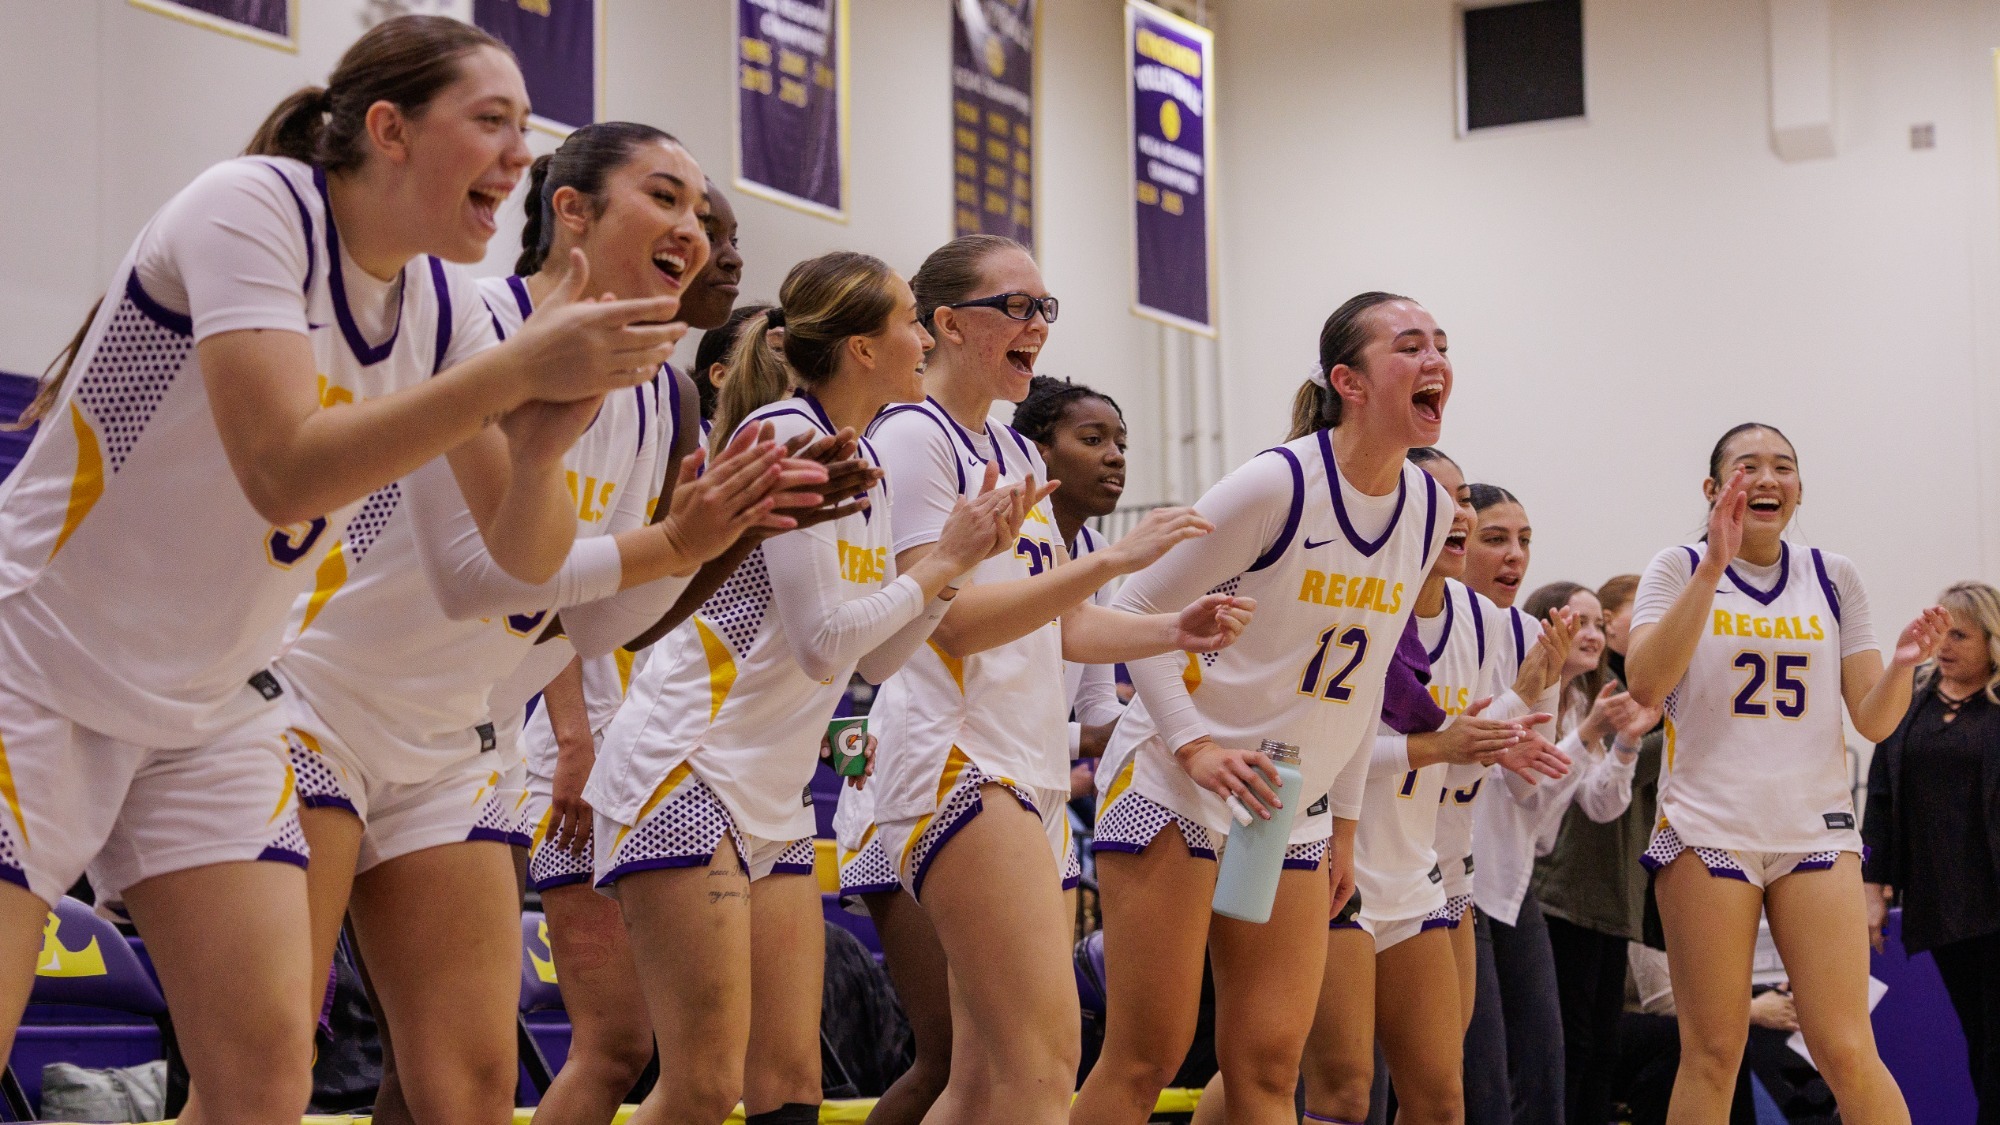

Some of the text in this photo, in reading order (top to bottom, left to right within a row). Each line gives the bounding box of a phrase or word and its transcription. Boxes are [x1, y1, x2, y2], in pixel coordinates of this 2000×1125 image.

[1298, 569, 1404, 615] REGALS
[1713, 609, 1825, 641] REGALS
[1297, 622, 1372, 704] 12
[1731, 649, 1811, 721] 25
[838, 726, 863, 757] G
